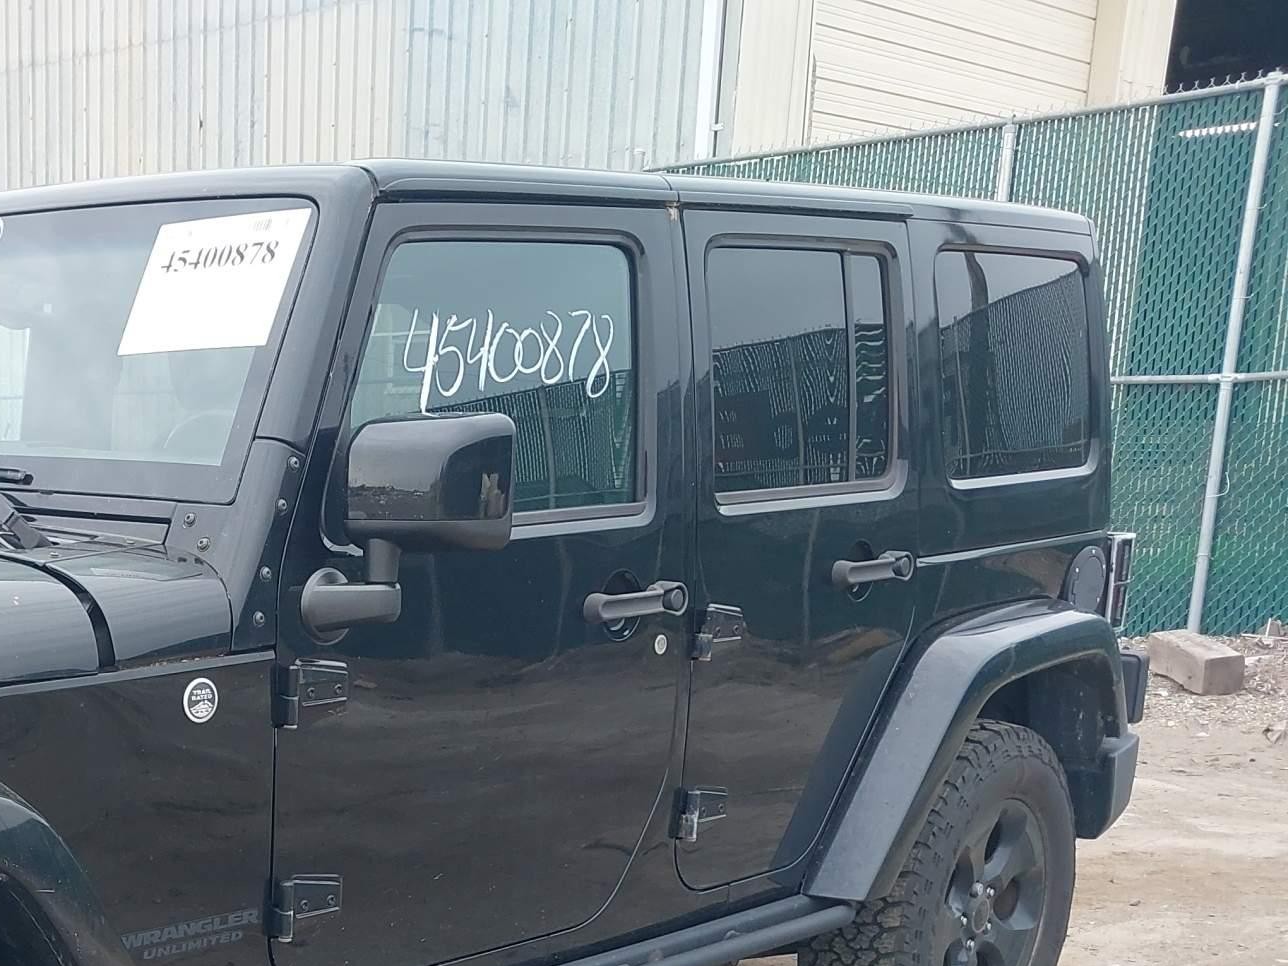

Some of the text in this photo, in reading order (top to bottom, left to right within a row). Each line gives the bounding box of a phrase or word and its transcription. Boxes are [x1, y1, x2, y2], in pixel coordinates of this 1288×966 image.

[161, 240, 279, 273] 45400878
[404, 309, 614, 416] 45400878
[121, 907, 259, 950] WRANGLER
[143, 931, 244, 960] UNLIMITED
